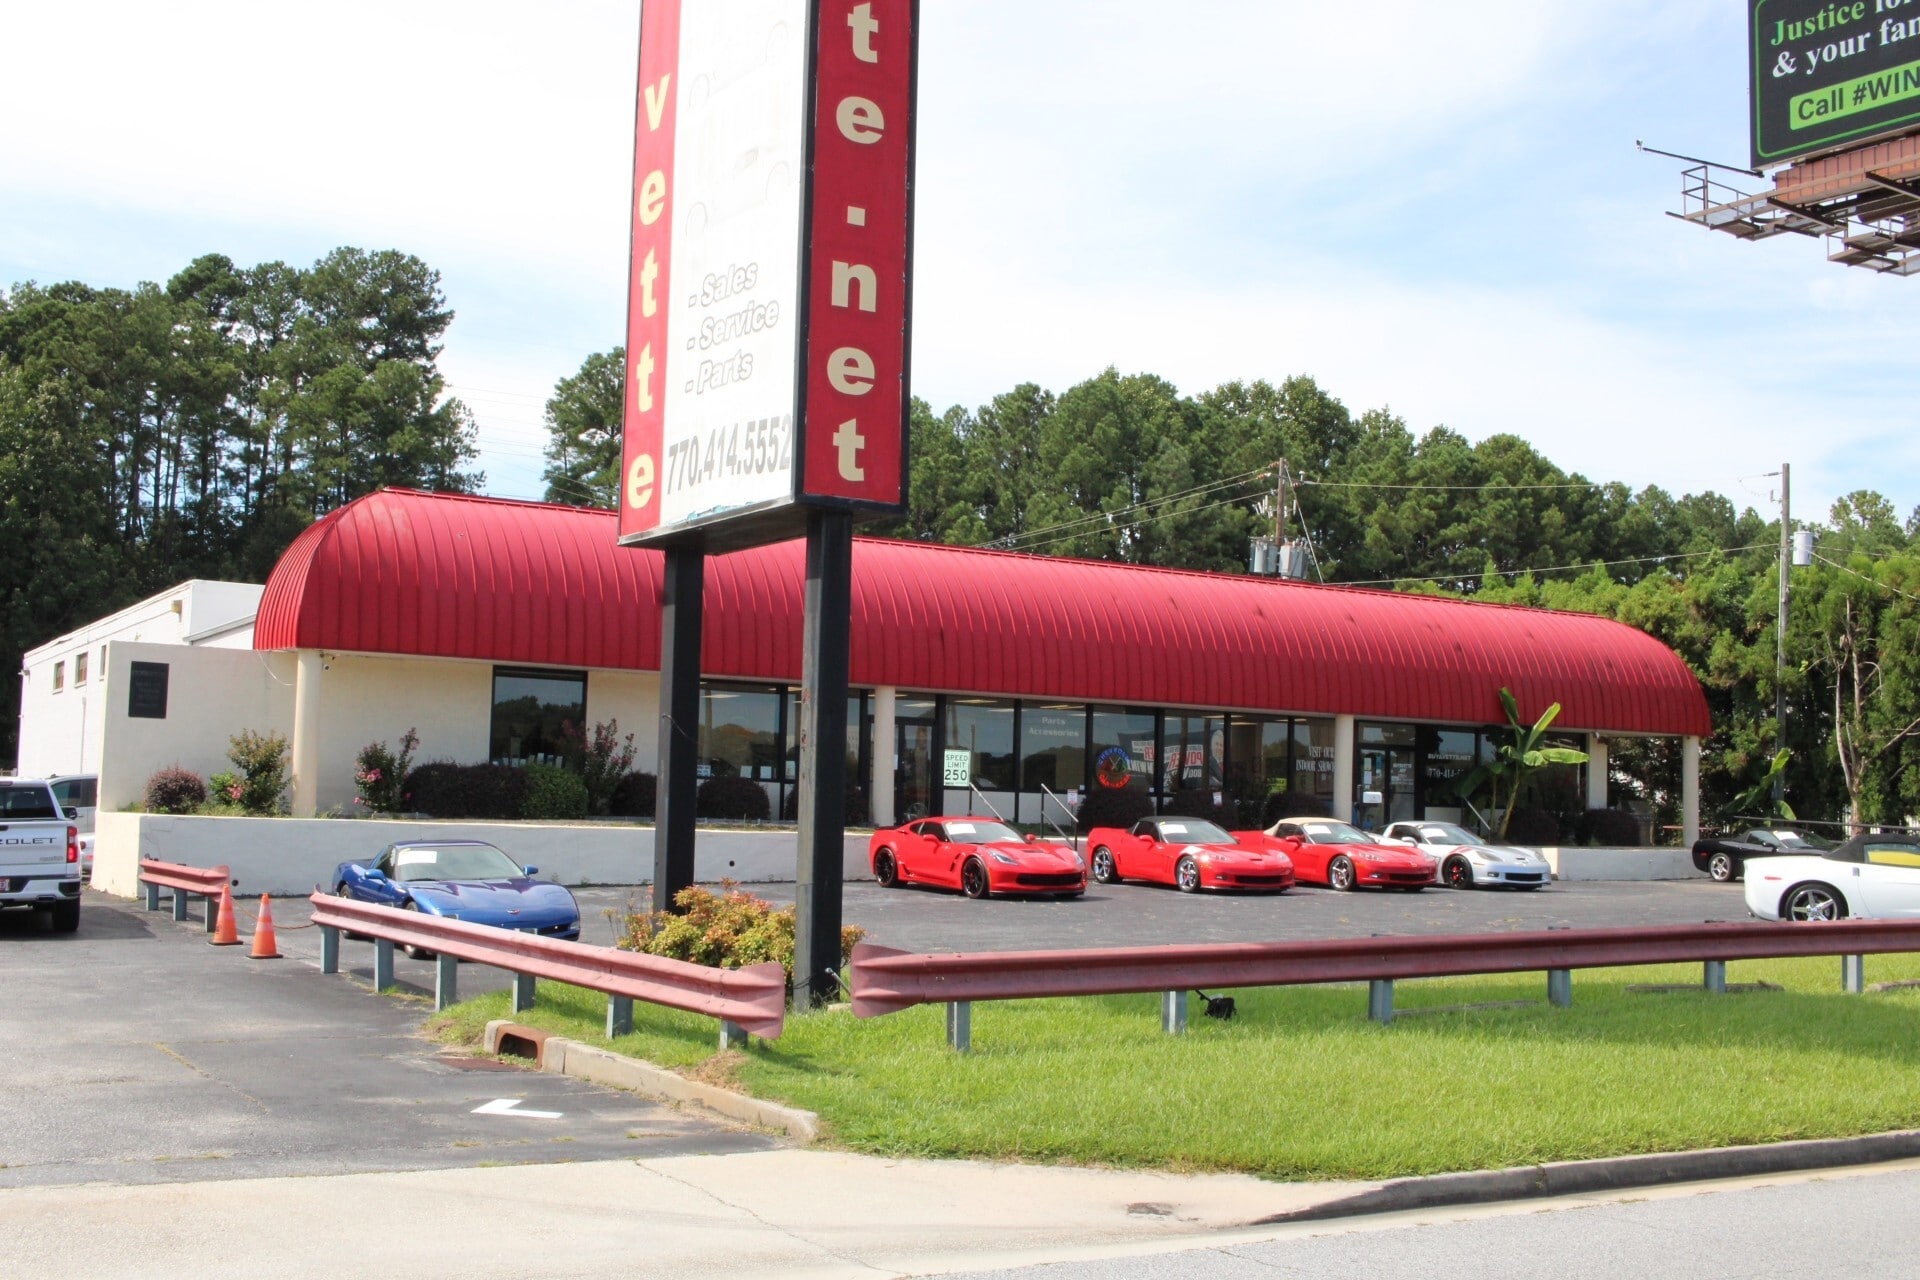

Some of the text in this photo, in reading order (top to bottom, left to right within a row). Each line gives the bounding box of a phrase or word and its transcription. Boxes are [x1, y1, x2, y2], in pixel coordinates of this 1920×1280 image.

[1771, 1, 1865, 46] Justice
[1772, 51, 1797, 78] &
[1806, 32, 1871, 75] your
[1798, 87, 1844, 121] Call
[701, 262, 758, 308] Sales
[699, 300, 780, 351] Service
[697, 349, 753, 395] Parts
[667, 413, 792, 495] 770.414.5552
[1029, 727, 1079, 737] Accessories
[1041, 716, 1066, 725] Parts
[945, 769, 967, 781] 250
[946, 754, 968, 762] SPEED
